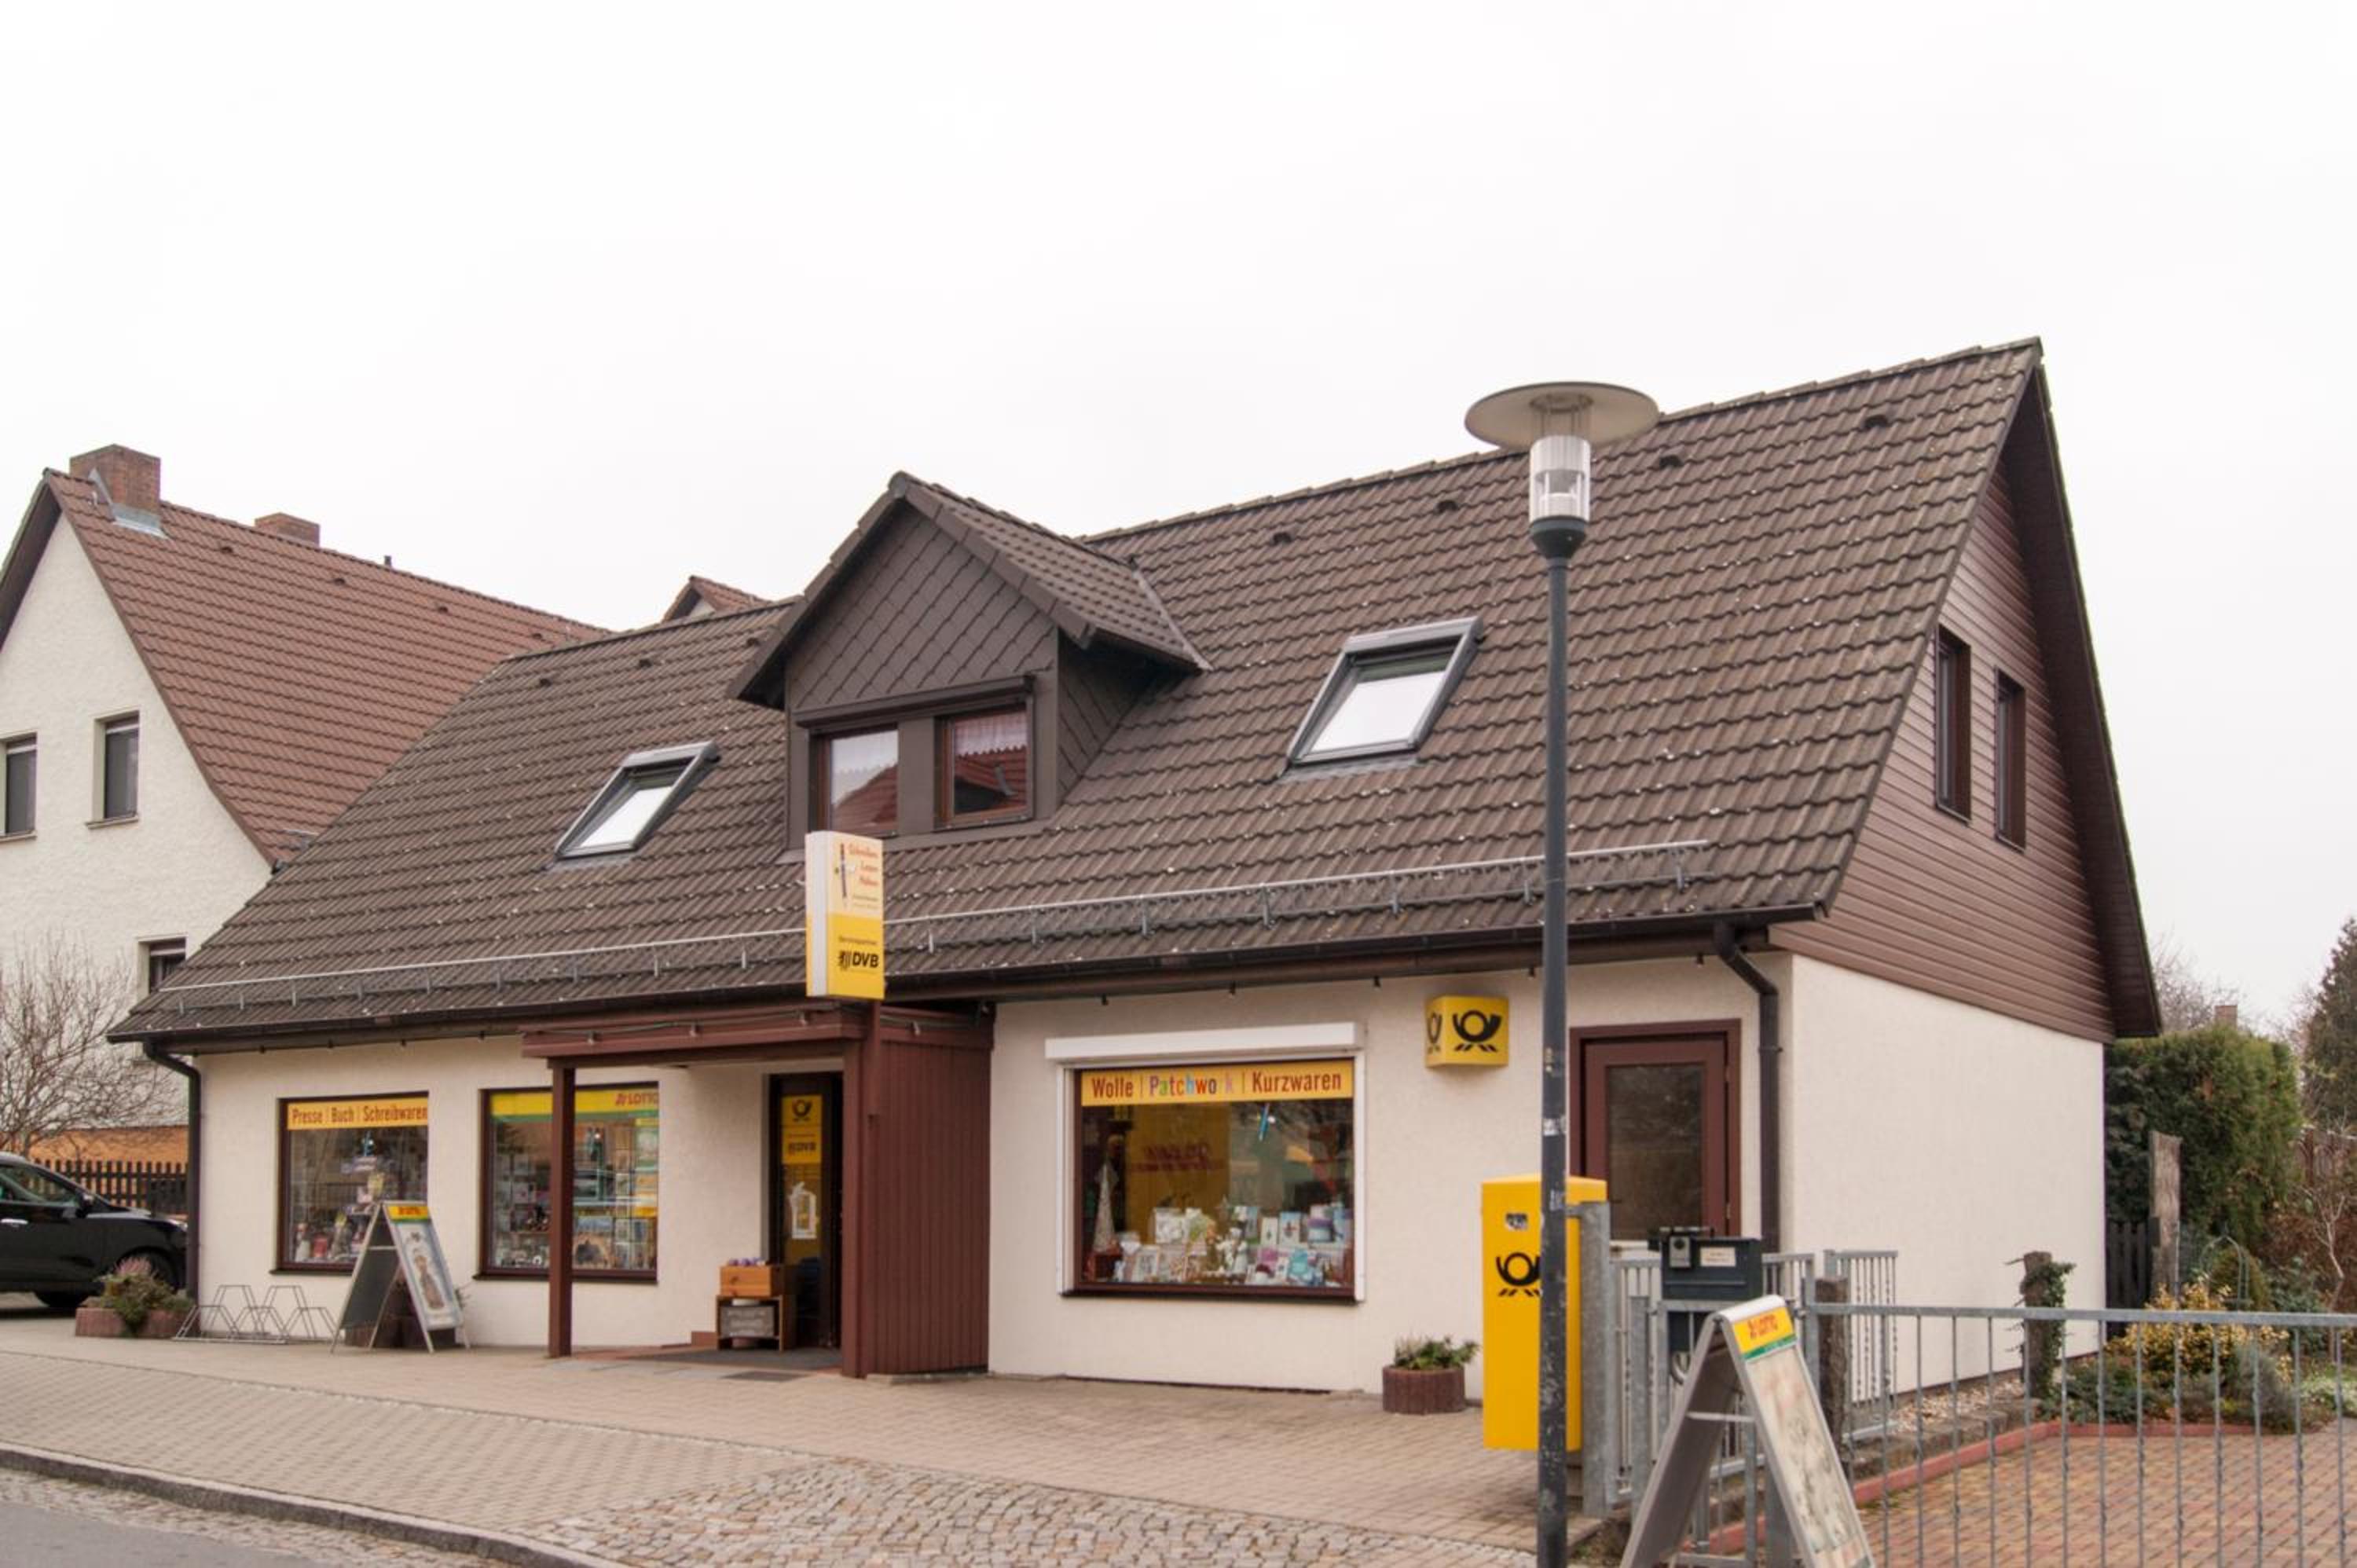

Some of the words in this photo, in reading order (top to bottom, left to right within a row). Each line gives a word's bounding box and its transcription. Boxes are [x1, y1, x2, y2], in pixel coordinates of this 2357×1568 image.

[852, 951, 879, 968] DVB
[1091, 1076, 1134, 1098] Wolle
[1149, 1073, 1234, 1097] Patchwok
[1252, 1071, 1341, 1093] Kurzwaren
[291, 1108, 323, 1124] Presse
[331, 1106, 354, 1123] Buch
[363, 1104, 428, 1122] Schreibwaren
